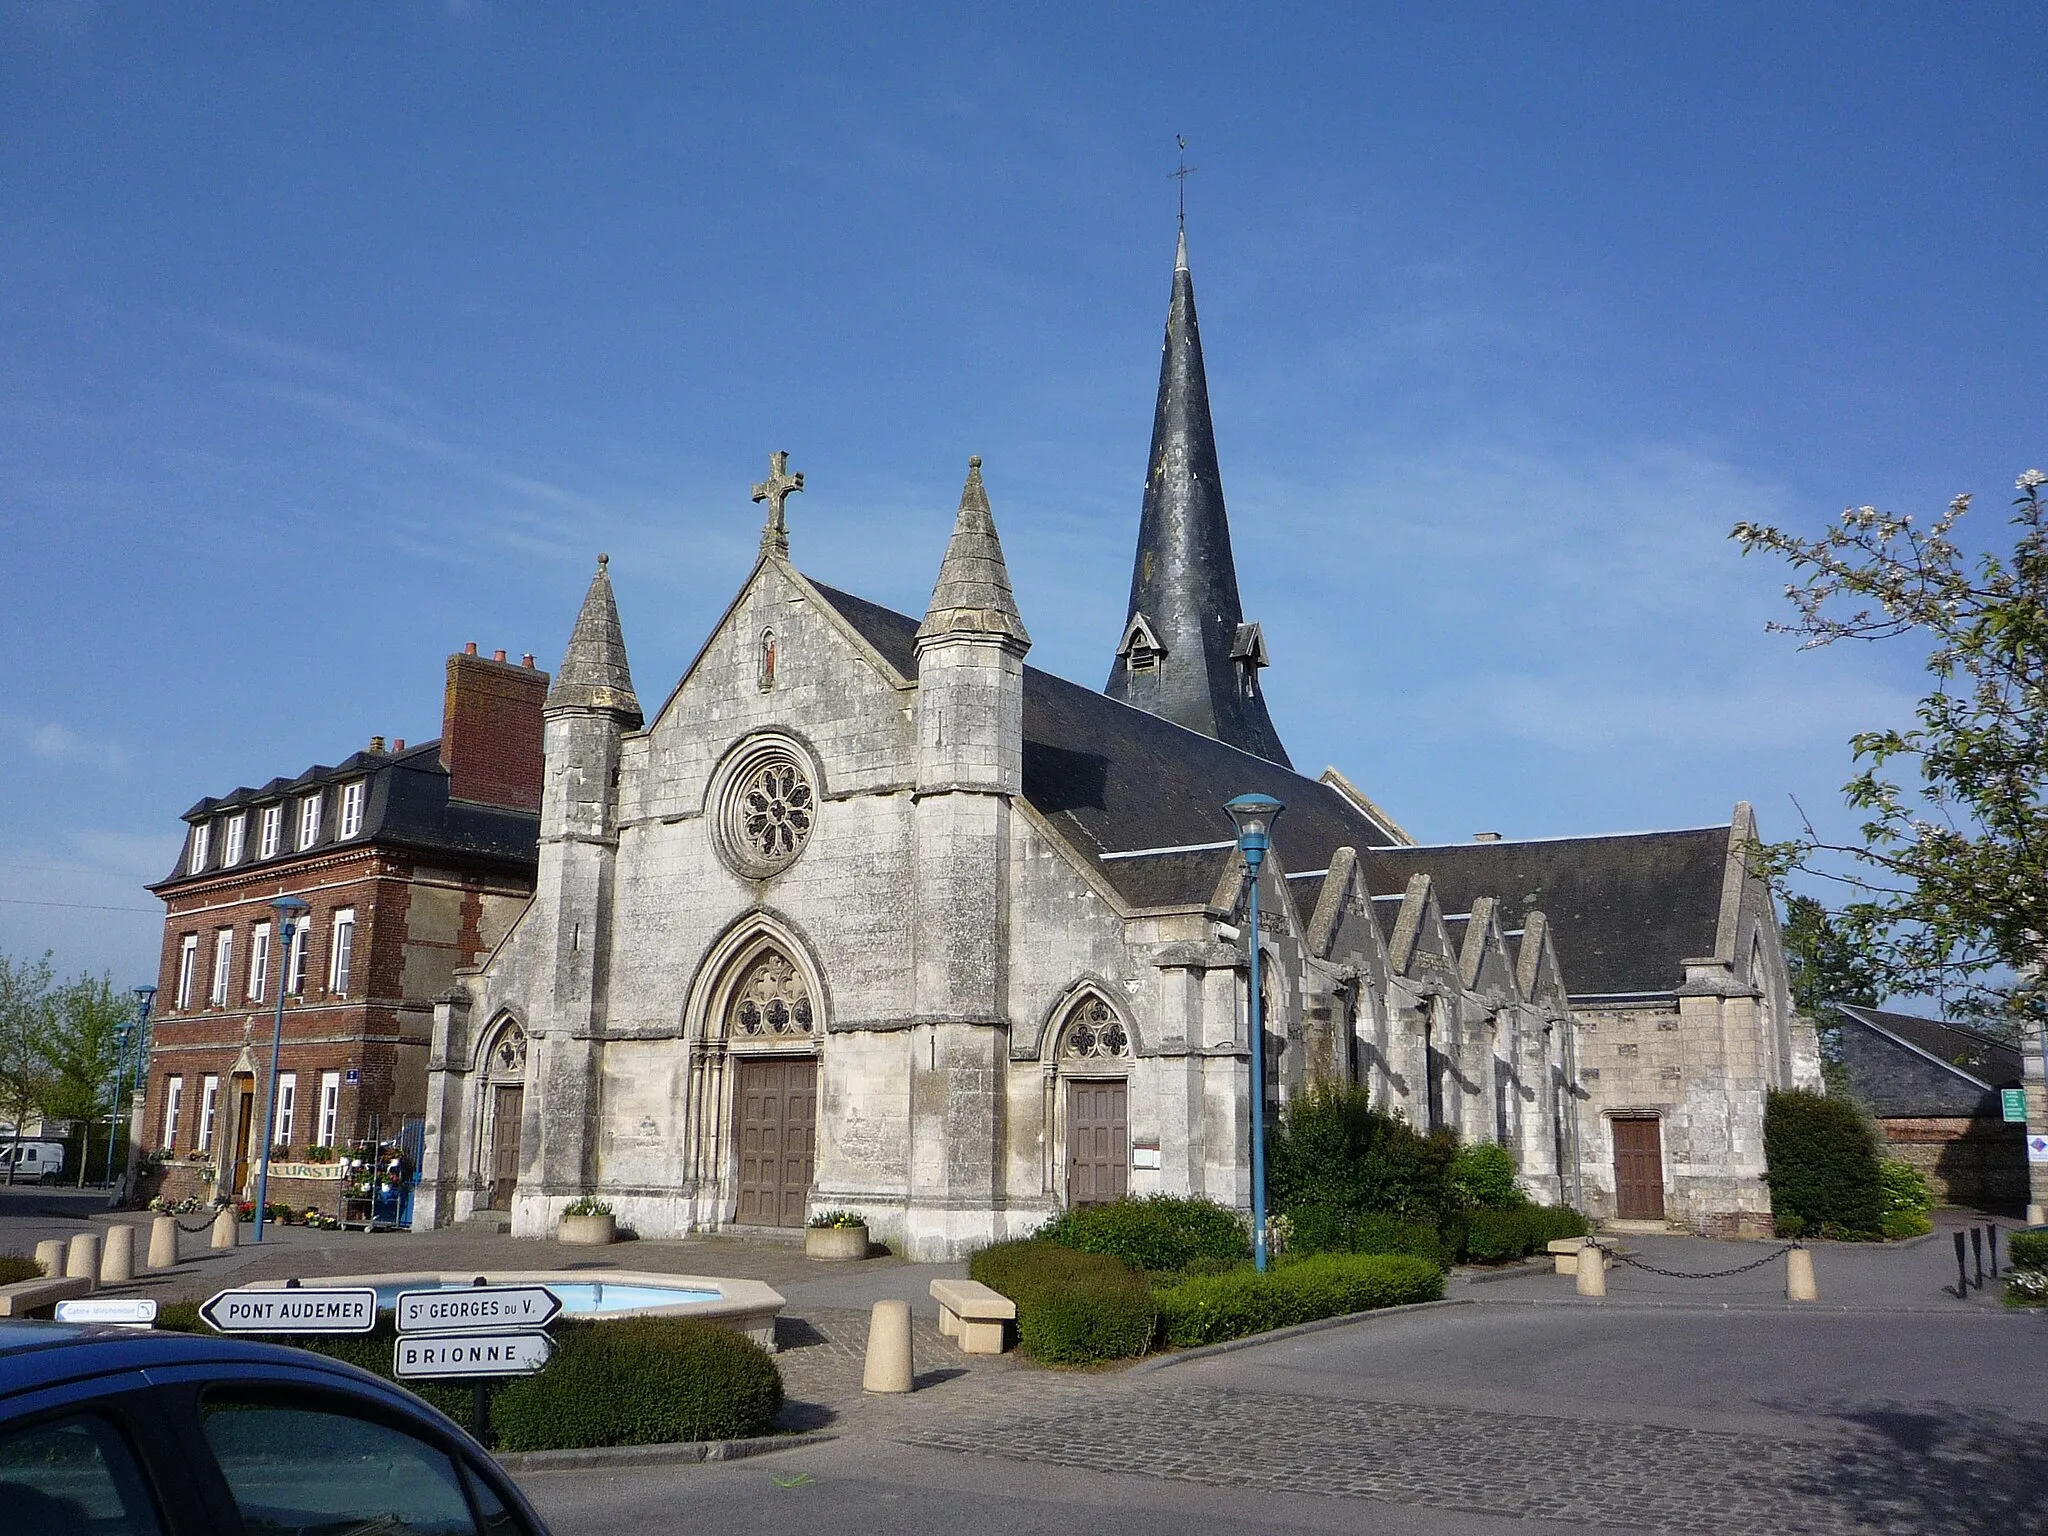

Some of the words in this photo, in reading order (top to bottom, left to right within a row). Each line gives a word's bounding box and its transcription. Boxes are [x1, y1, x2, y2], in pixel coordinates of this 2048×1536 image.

[229, 1304, 274, 1319] PONT
[279, 1303, 364, 1318] AUDEMER
[429, 1301, 499, 1319] GEORGES
[406, 1345, 516, 1364] BRIONNE
